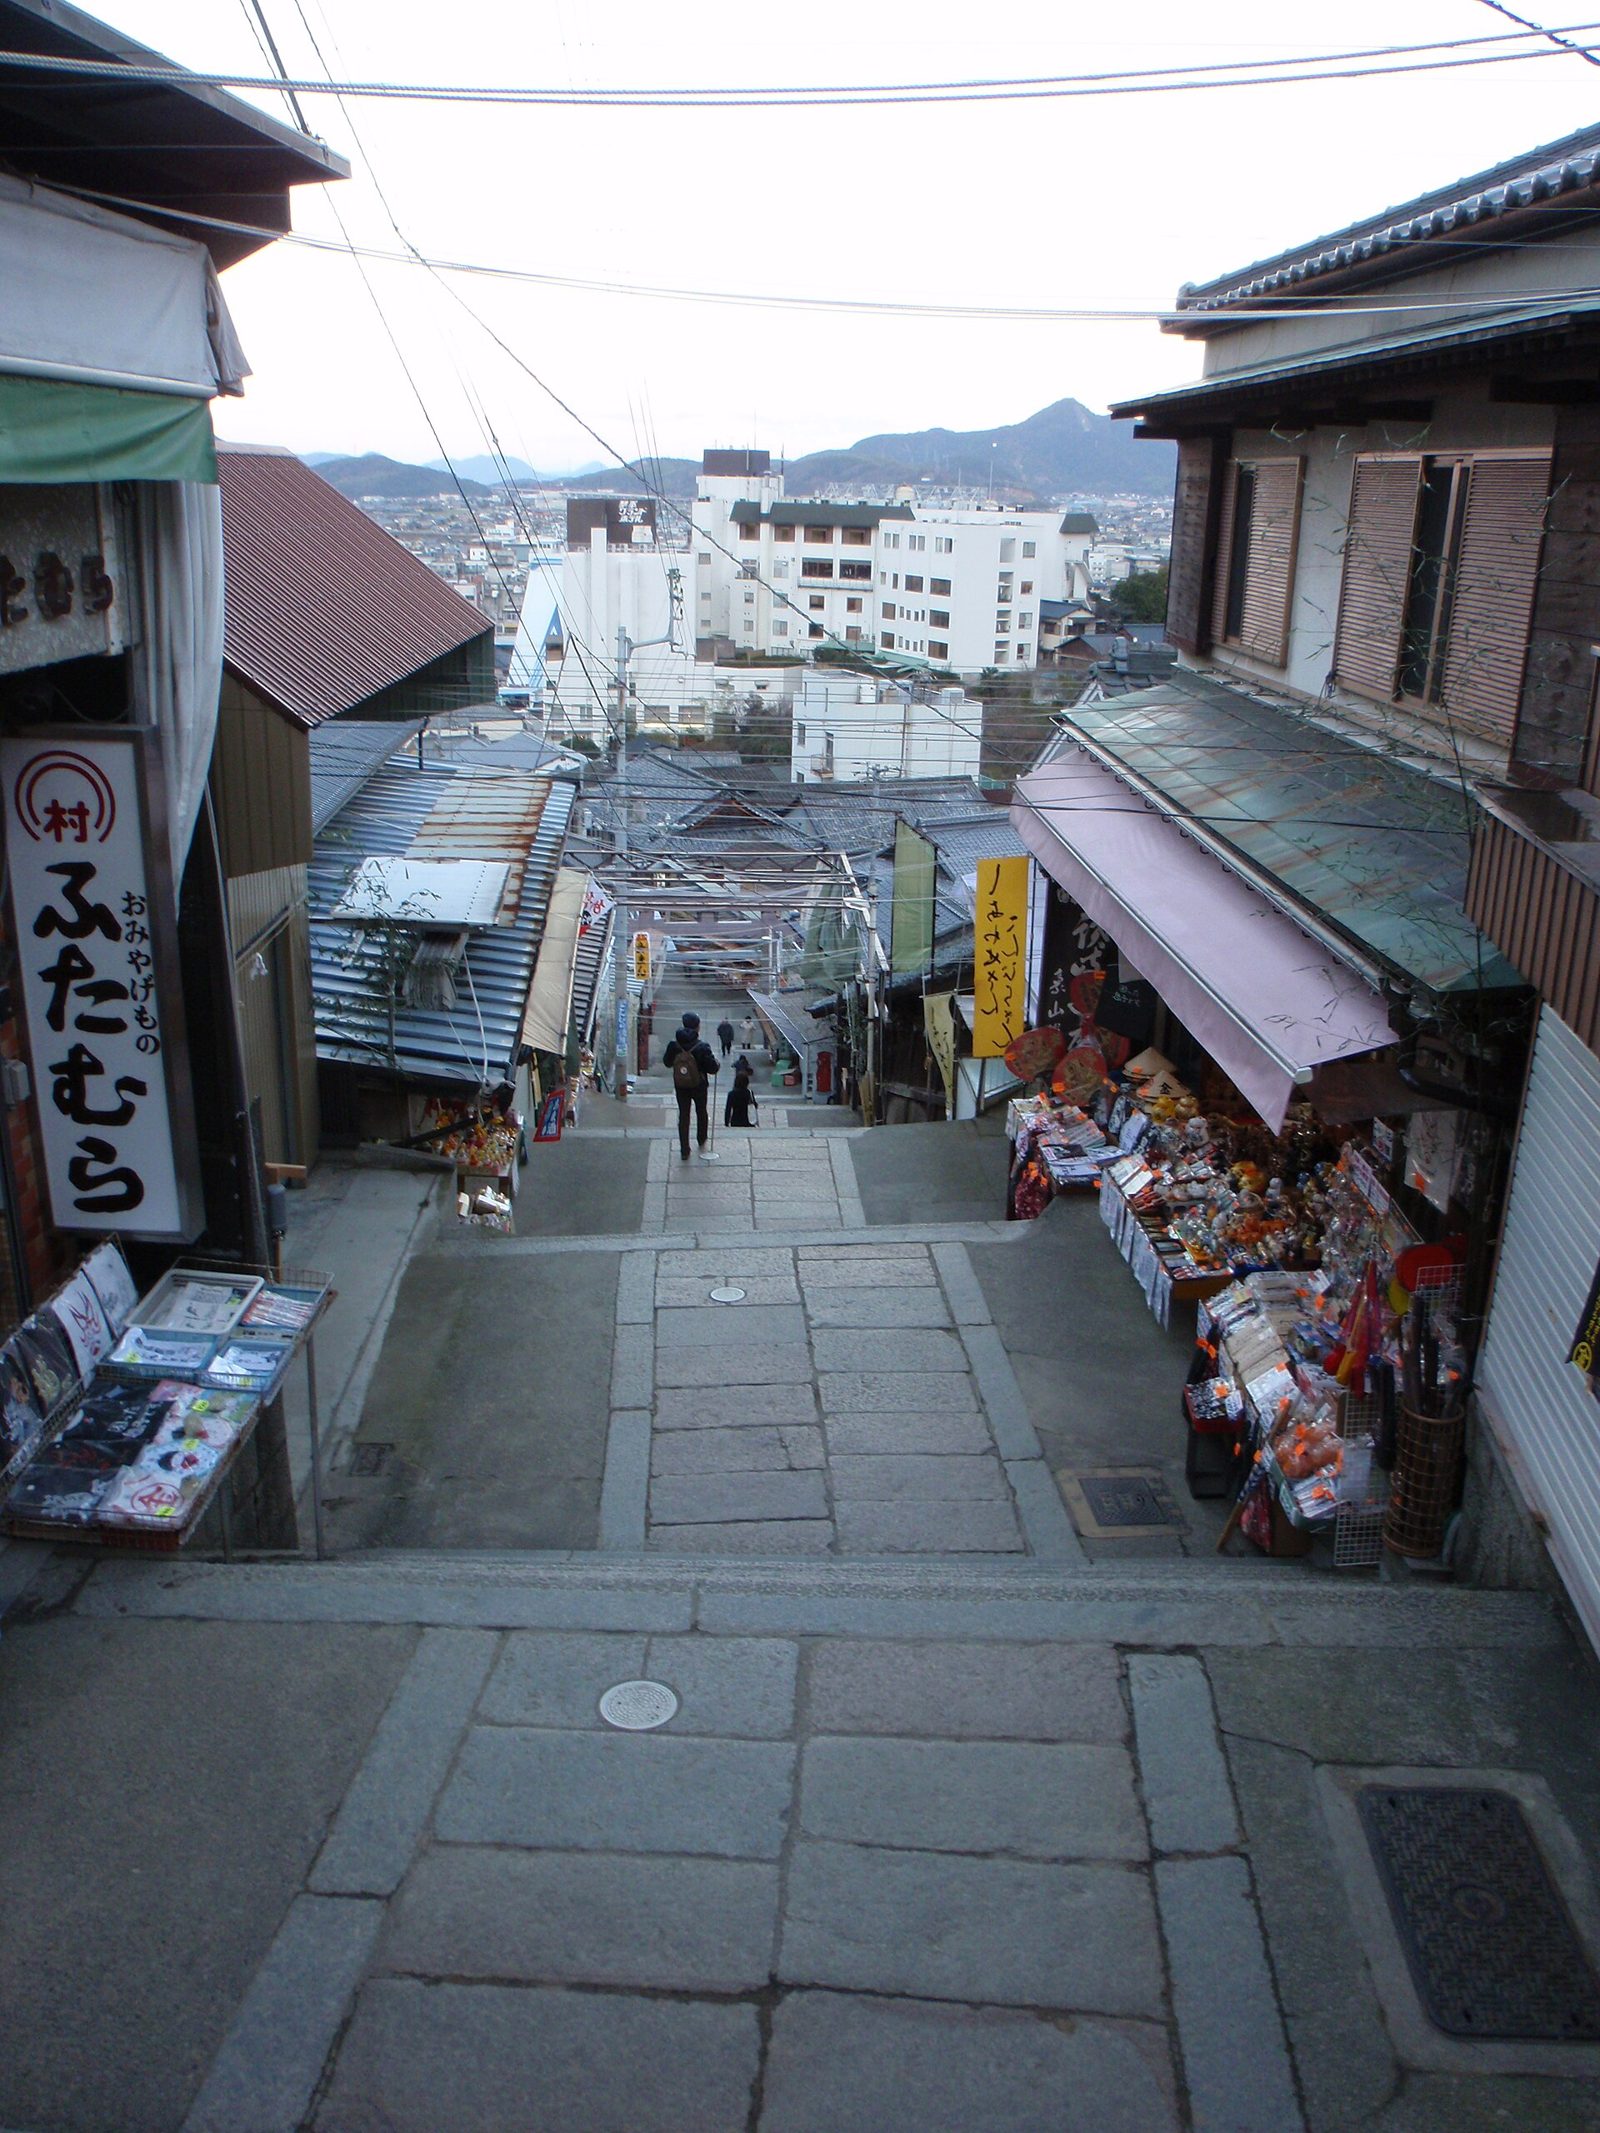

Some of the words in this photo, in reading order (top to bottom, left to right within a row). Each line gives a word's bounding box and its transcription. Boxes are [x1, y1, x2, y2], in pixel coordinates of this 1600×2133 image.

[43, 799, 90, 843] 村
[121, 891, 161, 1055] おみやげもの
[33, 862, 147, 1213] ふたむら
[1159, 1082, 1173, 1095] 金
